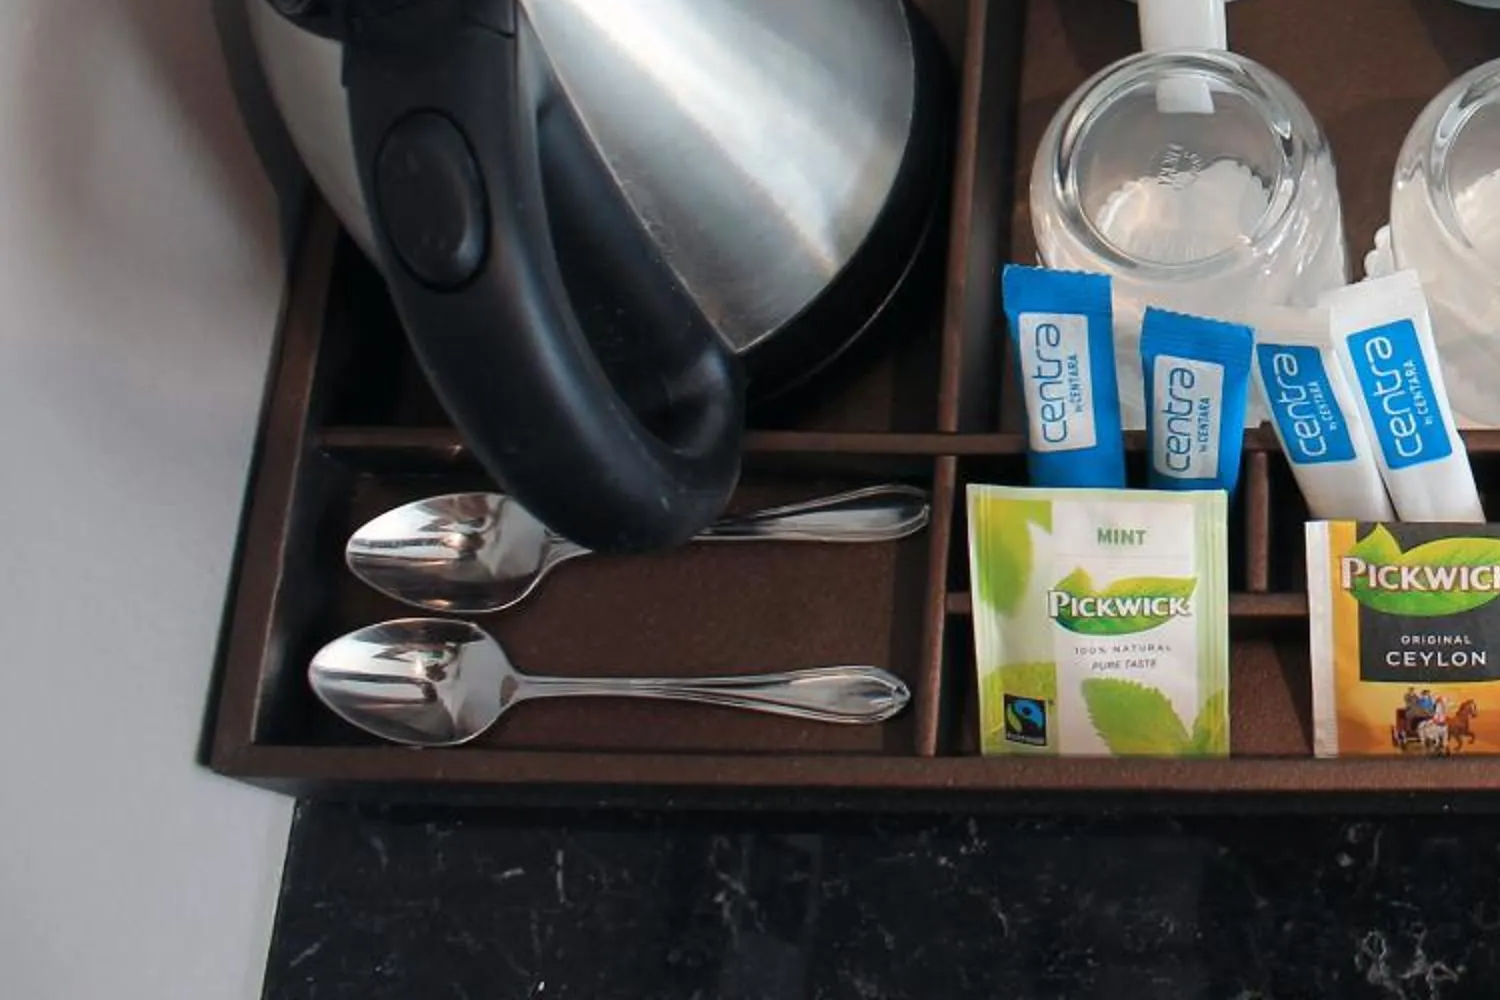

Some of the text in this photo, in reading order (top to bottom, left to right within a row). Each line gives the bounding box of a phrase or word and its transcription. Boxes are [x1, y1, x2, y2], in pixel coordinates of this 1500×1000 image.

[1032, 323, 1068, 443] centra
[1067, 354, 1082, 404] CENTARA
[1365, 336, 1424, 458] centra
[1402, 359, 1429, 415] CENTARA
[1162, 367, 1196, 472] centra
[1197, 396, 1212, 443] CENTARA
[1273, 353, 1328, 457] centra
[1096, 528, 1147, 546] MINT
[1048, 589, 1192, 620] PICKWICK
[1113, 643, 1173, 654] NATURAL
[1385, 650, 1488, 668] CEYLON
[1400, 634, 1473, 646] ORIGINAL
[1091, 658, 1157, 671] PURE TASTE
